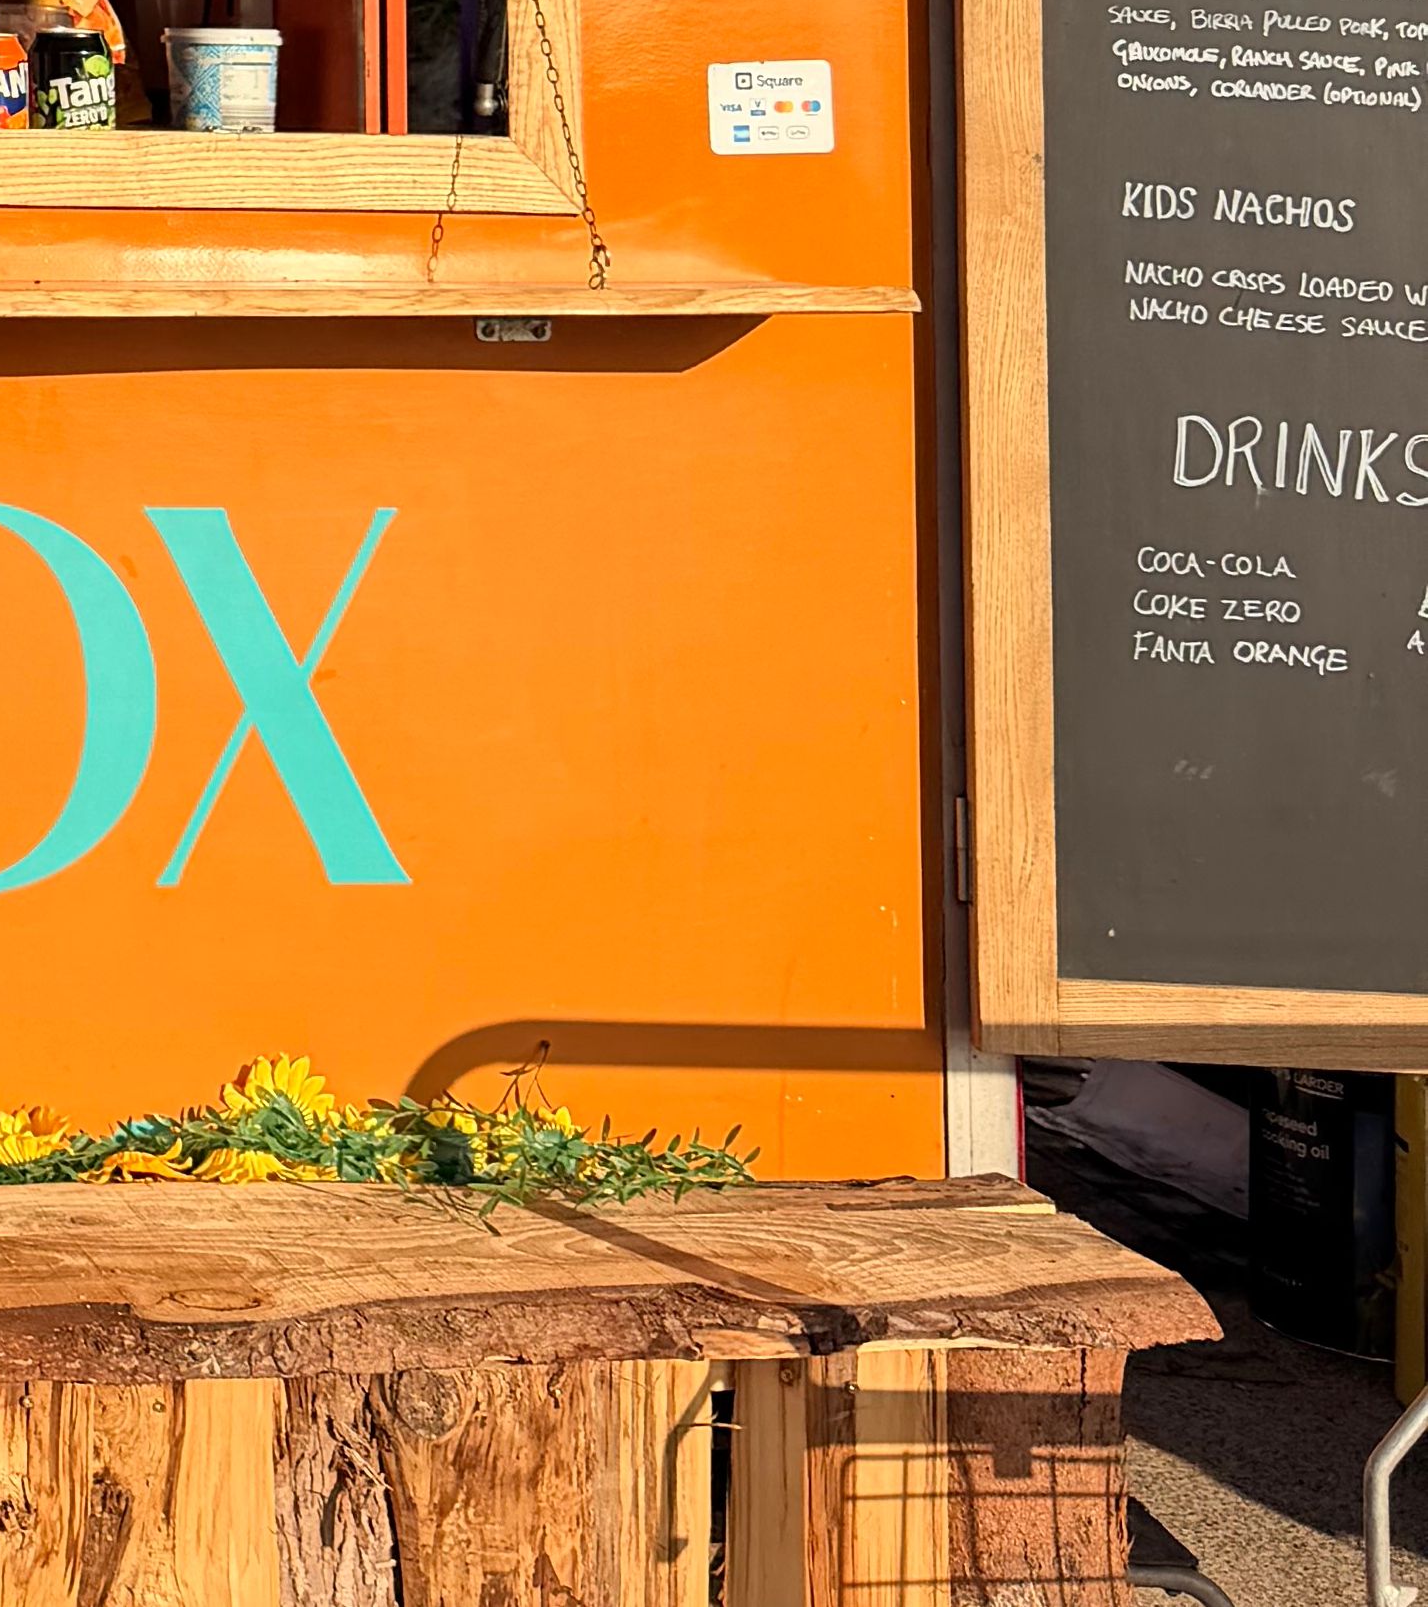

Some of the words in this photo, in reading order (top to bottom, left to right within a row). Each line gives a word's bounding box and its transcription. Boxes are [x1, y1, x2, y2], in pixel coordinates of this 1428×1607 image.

[1108, 6, 1176, 31] SAUCE,
[1191, 8, 1253, 31] BIRRIA
[1263, 10, 1332, 37] PULLED
[1339, 18, 1389, 41] PORK,
[1230, 45, 1294, 69] RANCH
[1374, 56, 1421, 80] PINK
[756, 74, 804, 90] Square
[1117, 73, 1198, 97] ONIONS,
[1210, 79, 1317, 101] CORIANDER
[1323, 81, 1422, 113] (OPTIONAL)
[720, 103, 743, 112] VISA
[1121, 181, 1197, 220] KIDS
[1213, 189, 1356, 233] NACHOS
[1125, 260, 1203, 288] NACHO
[1211, 268, 1286, 295] CRISPS
[1298, 272, 1394, 302] LOADED
[1130, 297, 1208, 325] NACHO
[1218, 306, 1327, 335] CHEESE
[1341, 317, 1428, 342] SAUCE
[1137, 546, 1297, 579] COCA-COLA
[1133, 589, 1208, 620] COKE
[1220, 599, 1302, 624] ZERO
[1133, 630, 1216, 665] FANTA
[1232, 640, 1349, 677] ORANGE
